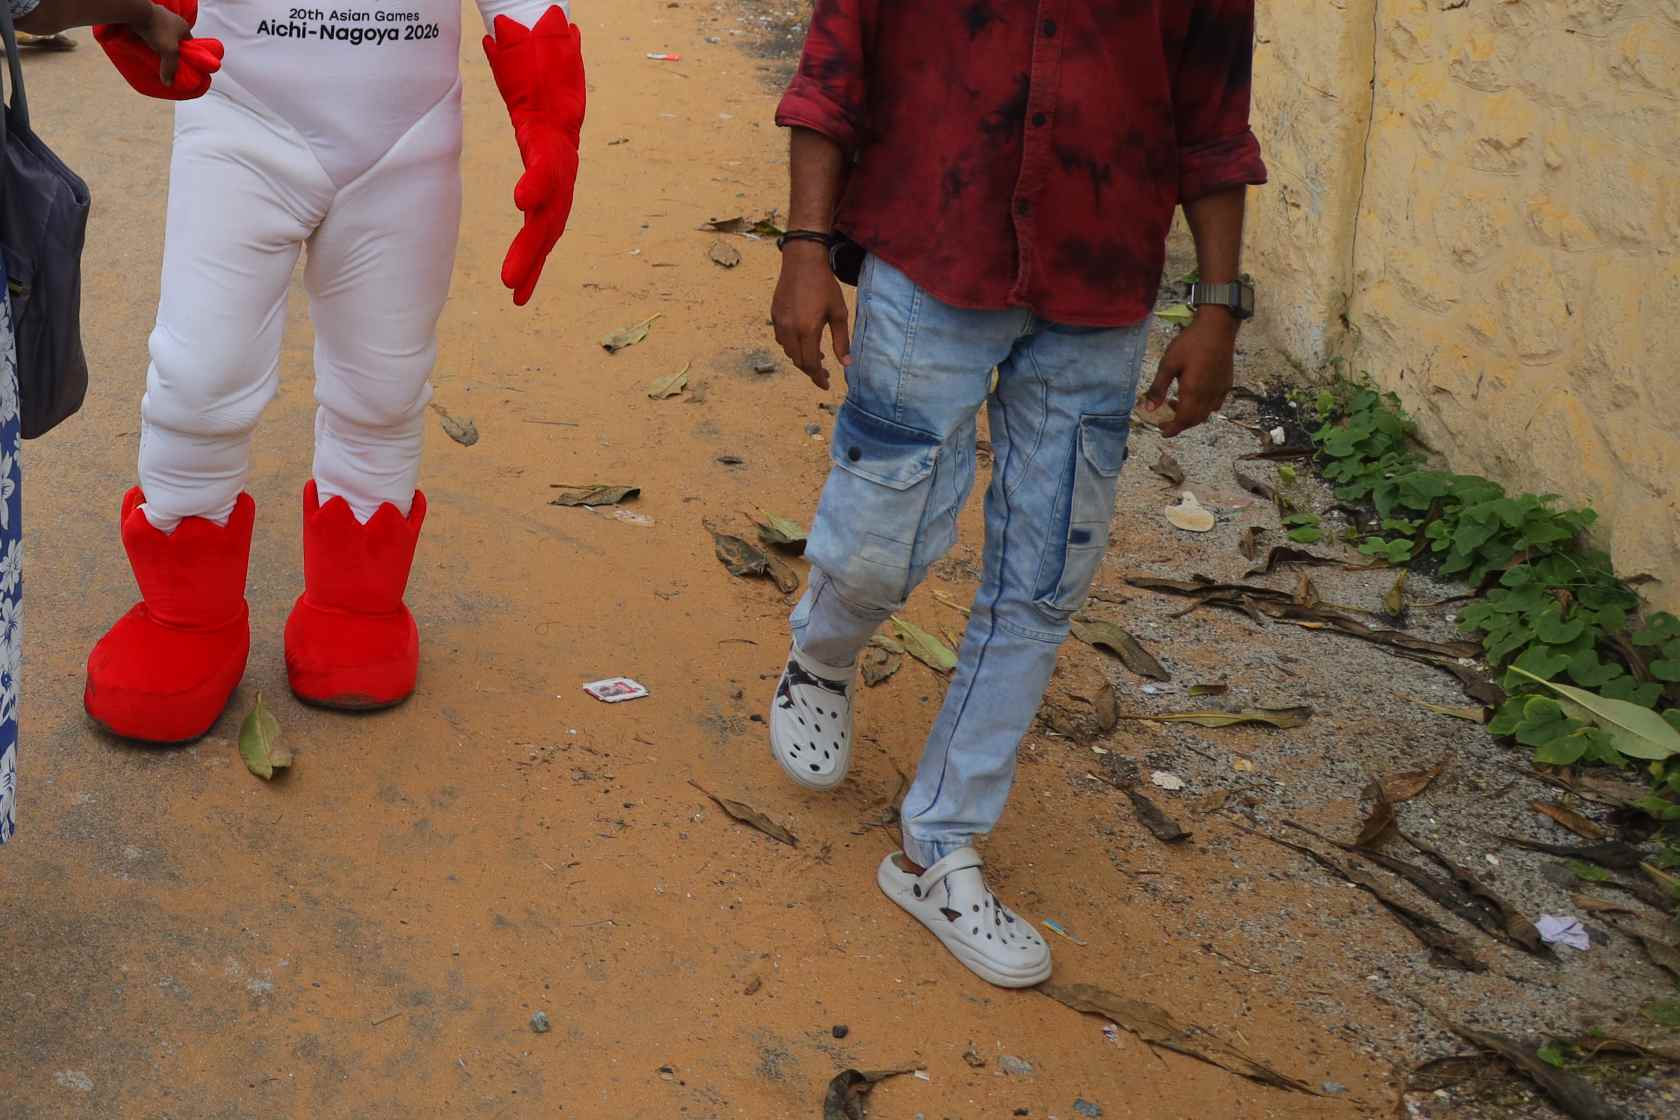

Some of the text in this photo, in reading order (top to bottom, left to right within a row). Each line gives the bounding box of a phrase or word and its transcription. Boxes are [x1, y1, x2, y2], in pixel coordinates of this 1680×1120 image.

[289, 8, 420, 22] 20th Asian Games
[257, 19, 440, 45] Aichi-Nagoya 2026
